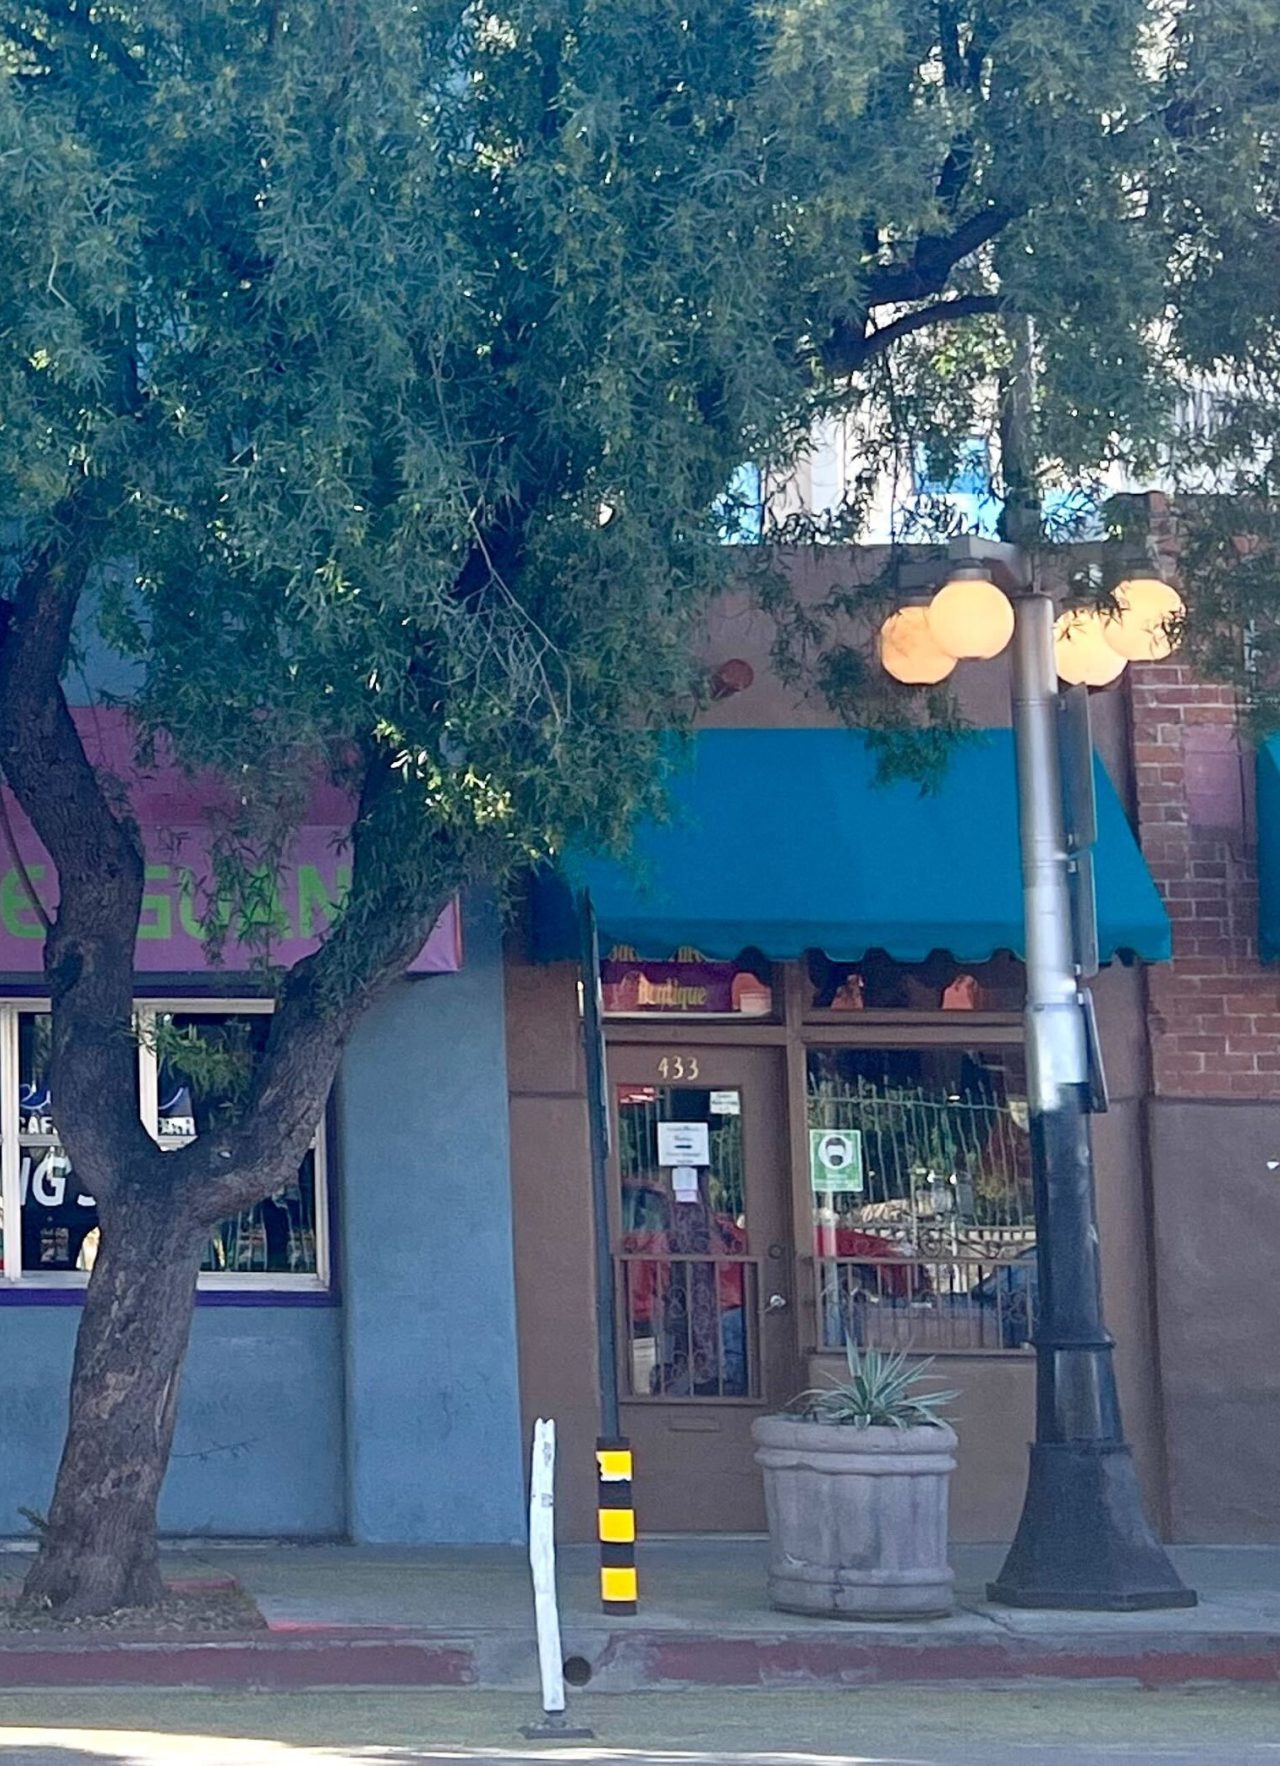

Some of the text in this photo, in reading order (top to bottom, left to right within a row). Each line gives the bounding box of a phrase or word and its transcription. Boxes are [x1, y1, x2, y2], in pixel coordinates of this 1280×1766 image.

[137, 864, 350, 940] GUAN
[658, 1056, 699, 1081] 433
[19, 1116, 58, 1133] CAF
